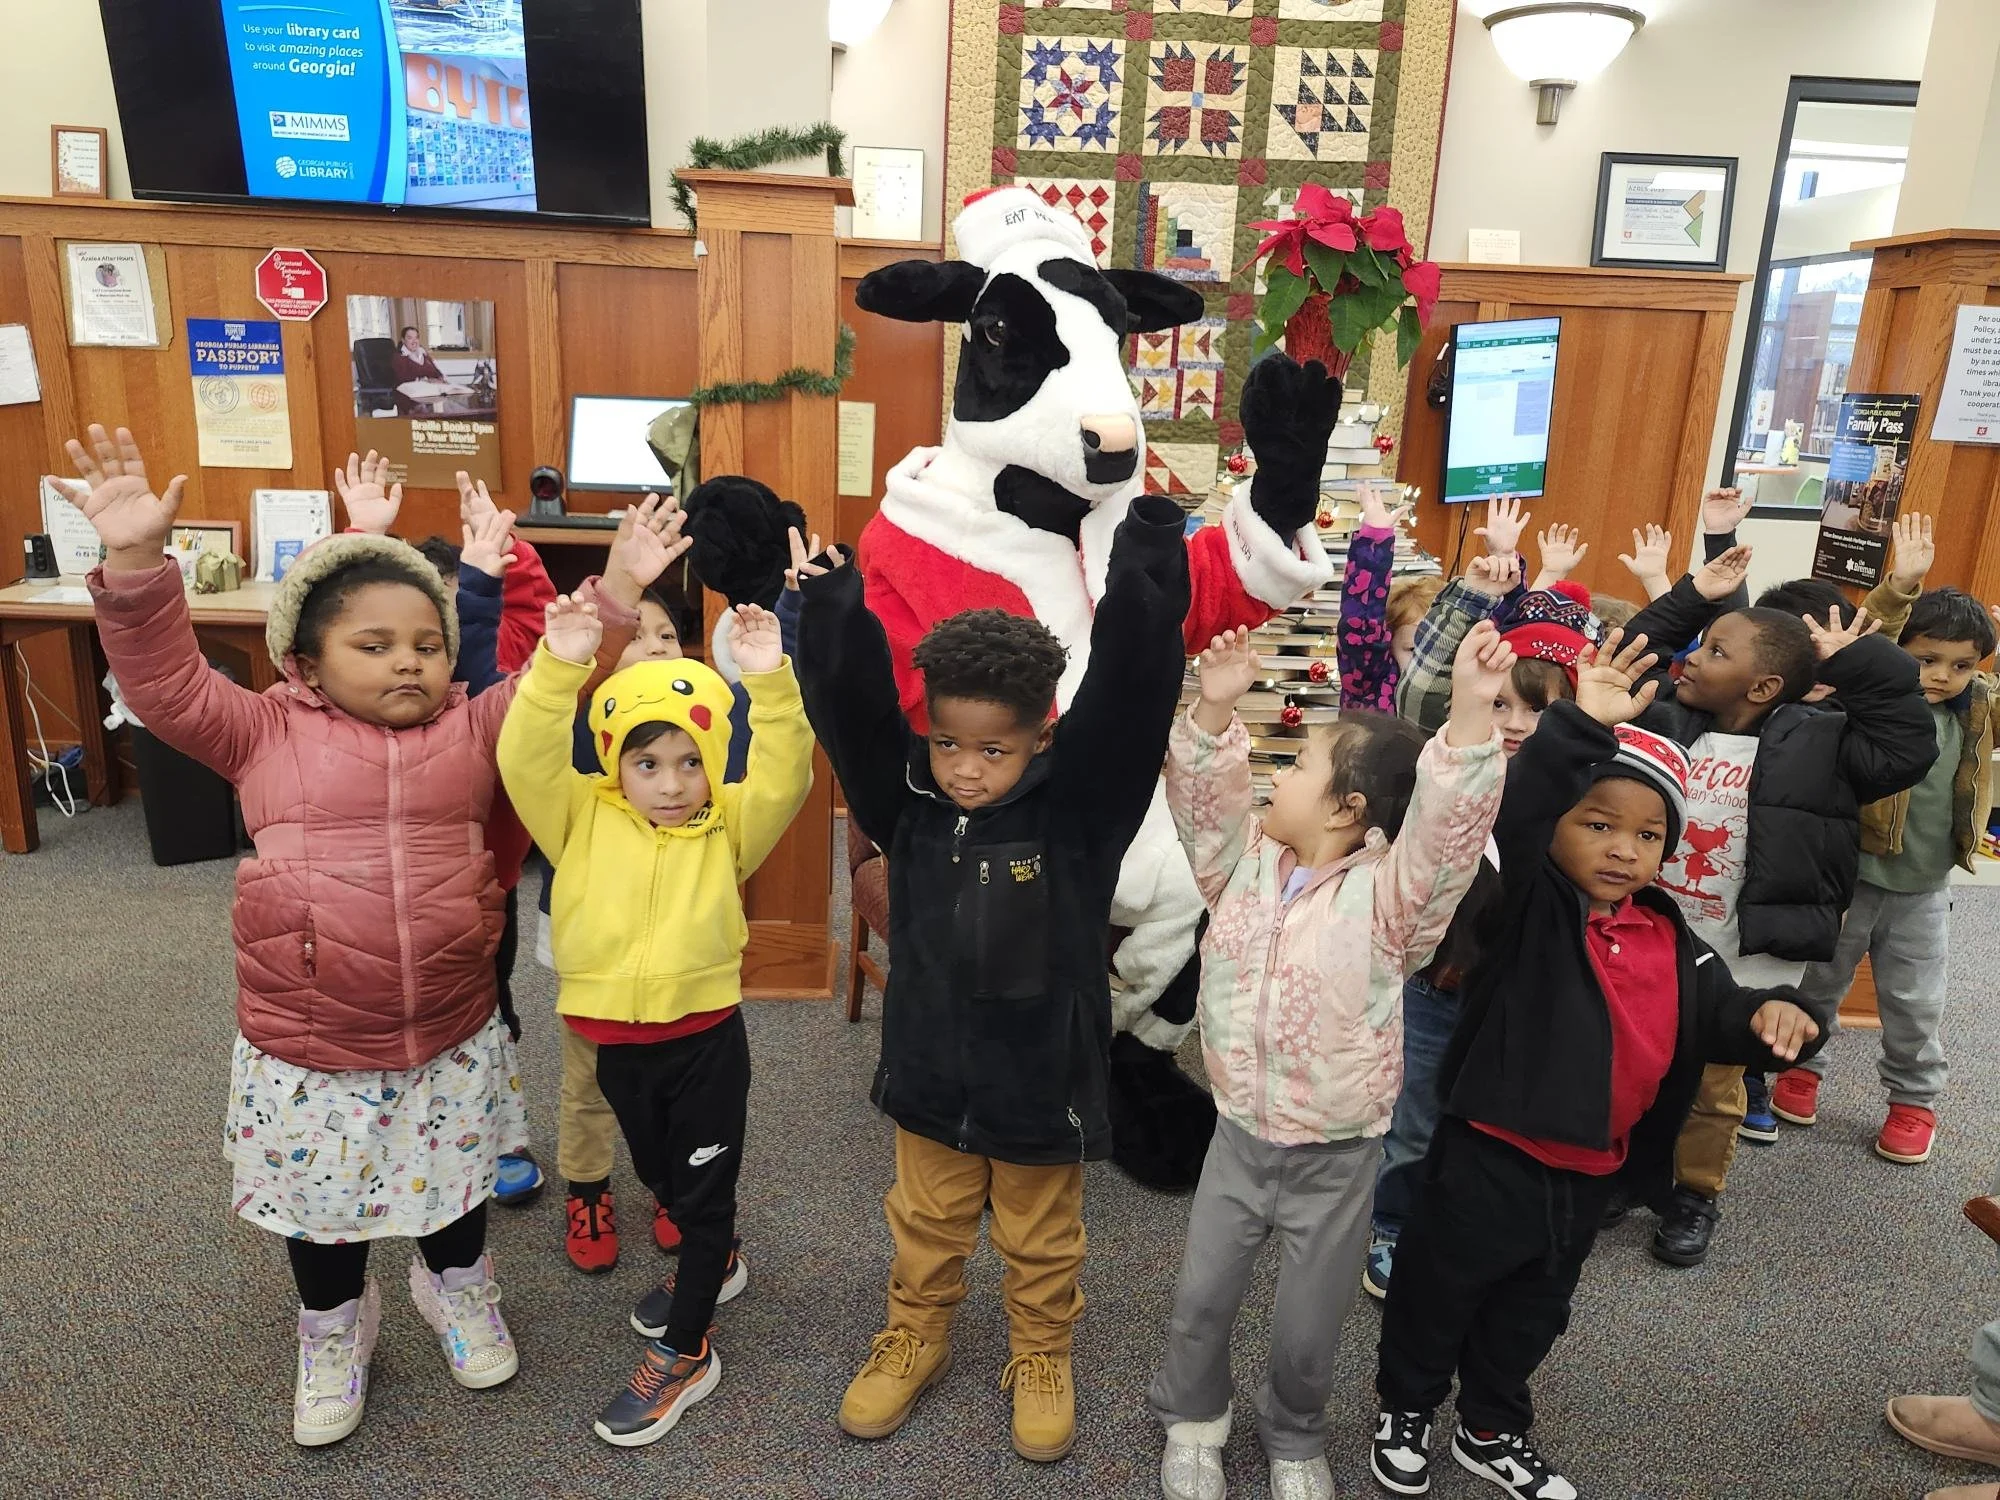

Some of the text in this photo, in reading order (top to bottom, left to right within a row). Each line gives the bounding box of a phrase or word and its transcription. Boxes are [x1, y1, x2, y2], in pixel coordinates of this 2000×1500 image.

[243, 23, 360, 40] Use your library card
[244, 42, 364, 58] to visit amazing places
[253, 58, 356, 78] around Georgia!
[291, 116, 346, 130] MIMMS
[299, 166, 348, 178] LIBRARY
[1006, 208, 1027, 226] EAT
[1974, 326, 1996, 334] Policy,
[196, 349, 280, 364] PASSPORT
[1971, 358, 1979, 366] by
[411, 420, 495, 434] Braille Books Open
[1847, 416, 1904, 437] Family Pass
[412, 431, 476, 443] Up Your World
[1854, 562, 1875, 576] Breman
[1711, 790, 1747, 809] Schoo
[1011, 864, 1031, 875] HARD
[1016, 871, 1035, 882] WEAR
[449, 1046, 479, 1073] LOVE
